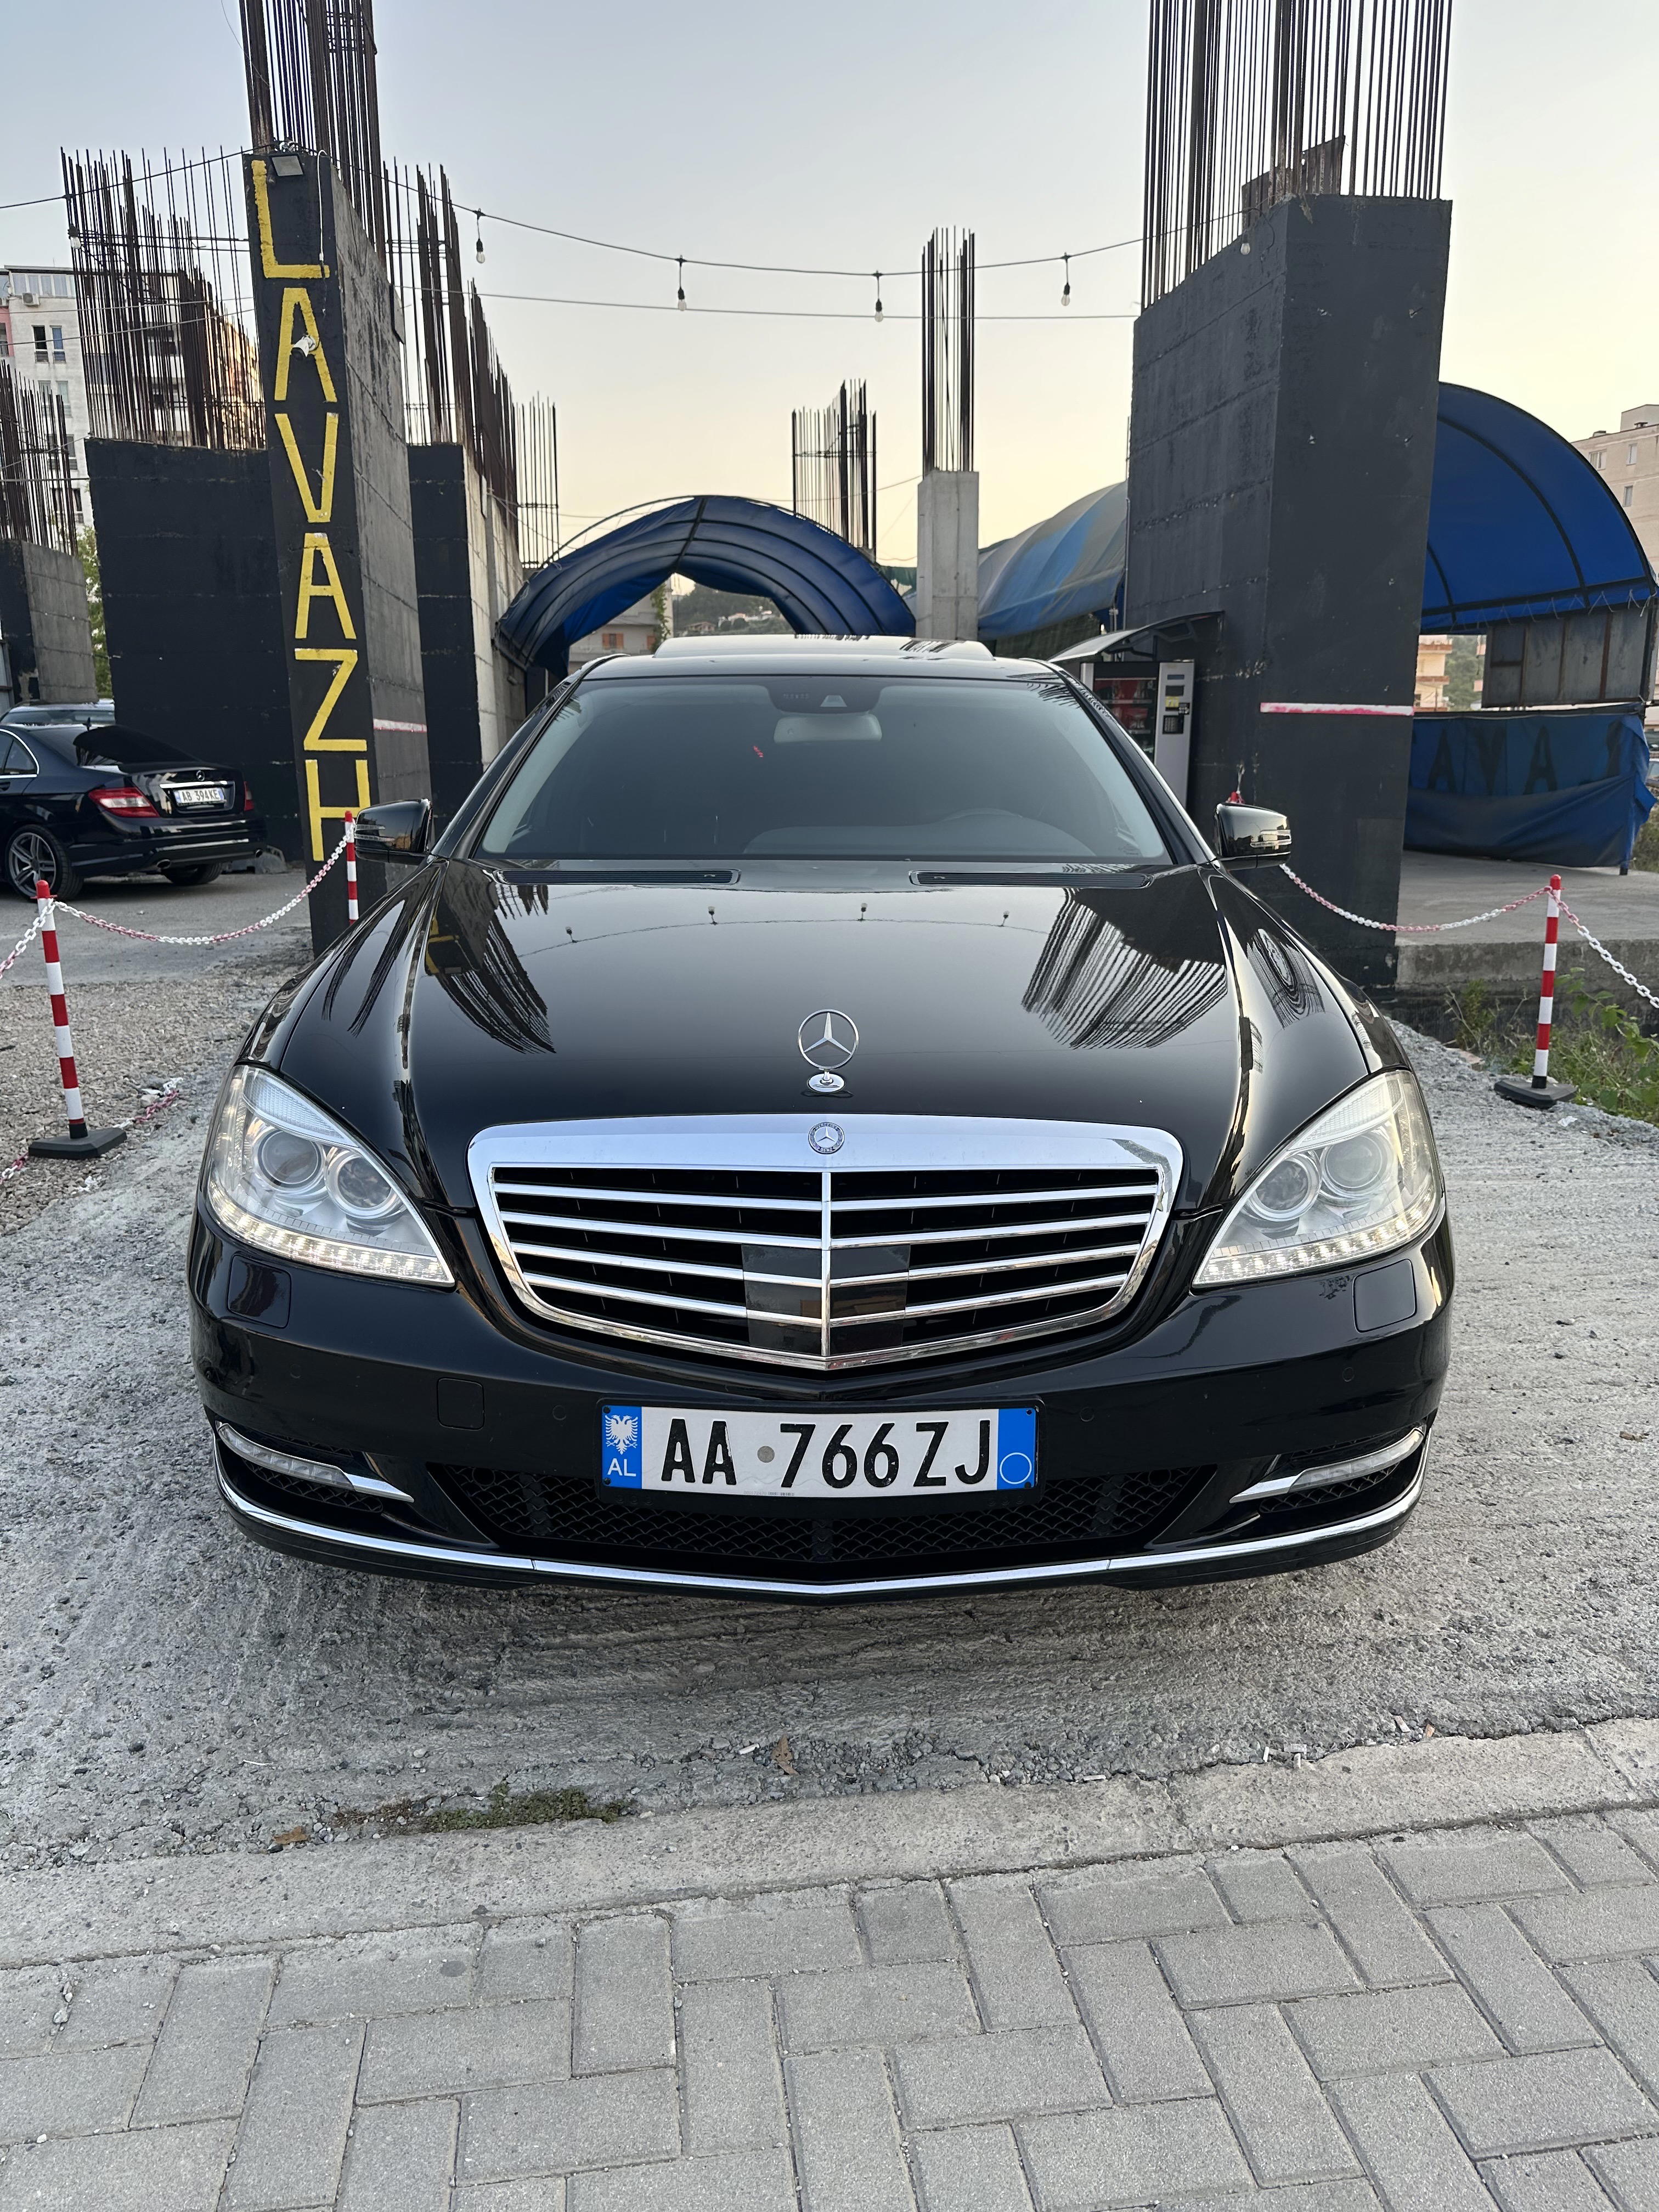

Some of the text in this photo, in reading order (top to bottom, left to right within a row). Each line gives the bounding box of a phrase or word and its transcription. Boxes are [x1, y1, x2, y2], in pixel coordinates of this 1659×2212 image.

[251, 160, 371, 861] LAVAZH
[182, 790, 219, 801] AB 394KE
[608, 1458, 637, 1477] AL
[661, 1418, 991, 1488] AA 766ZJ
